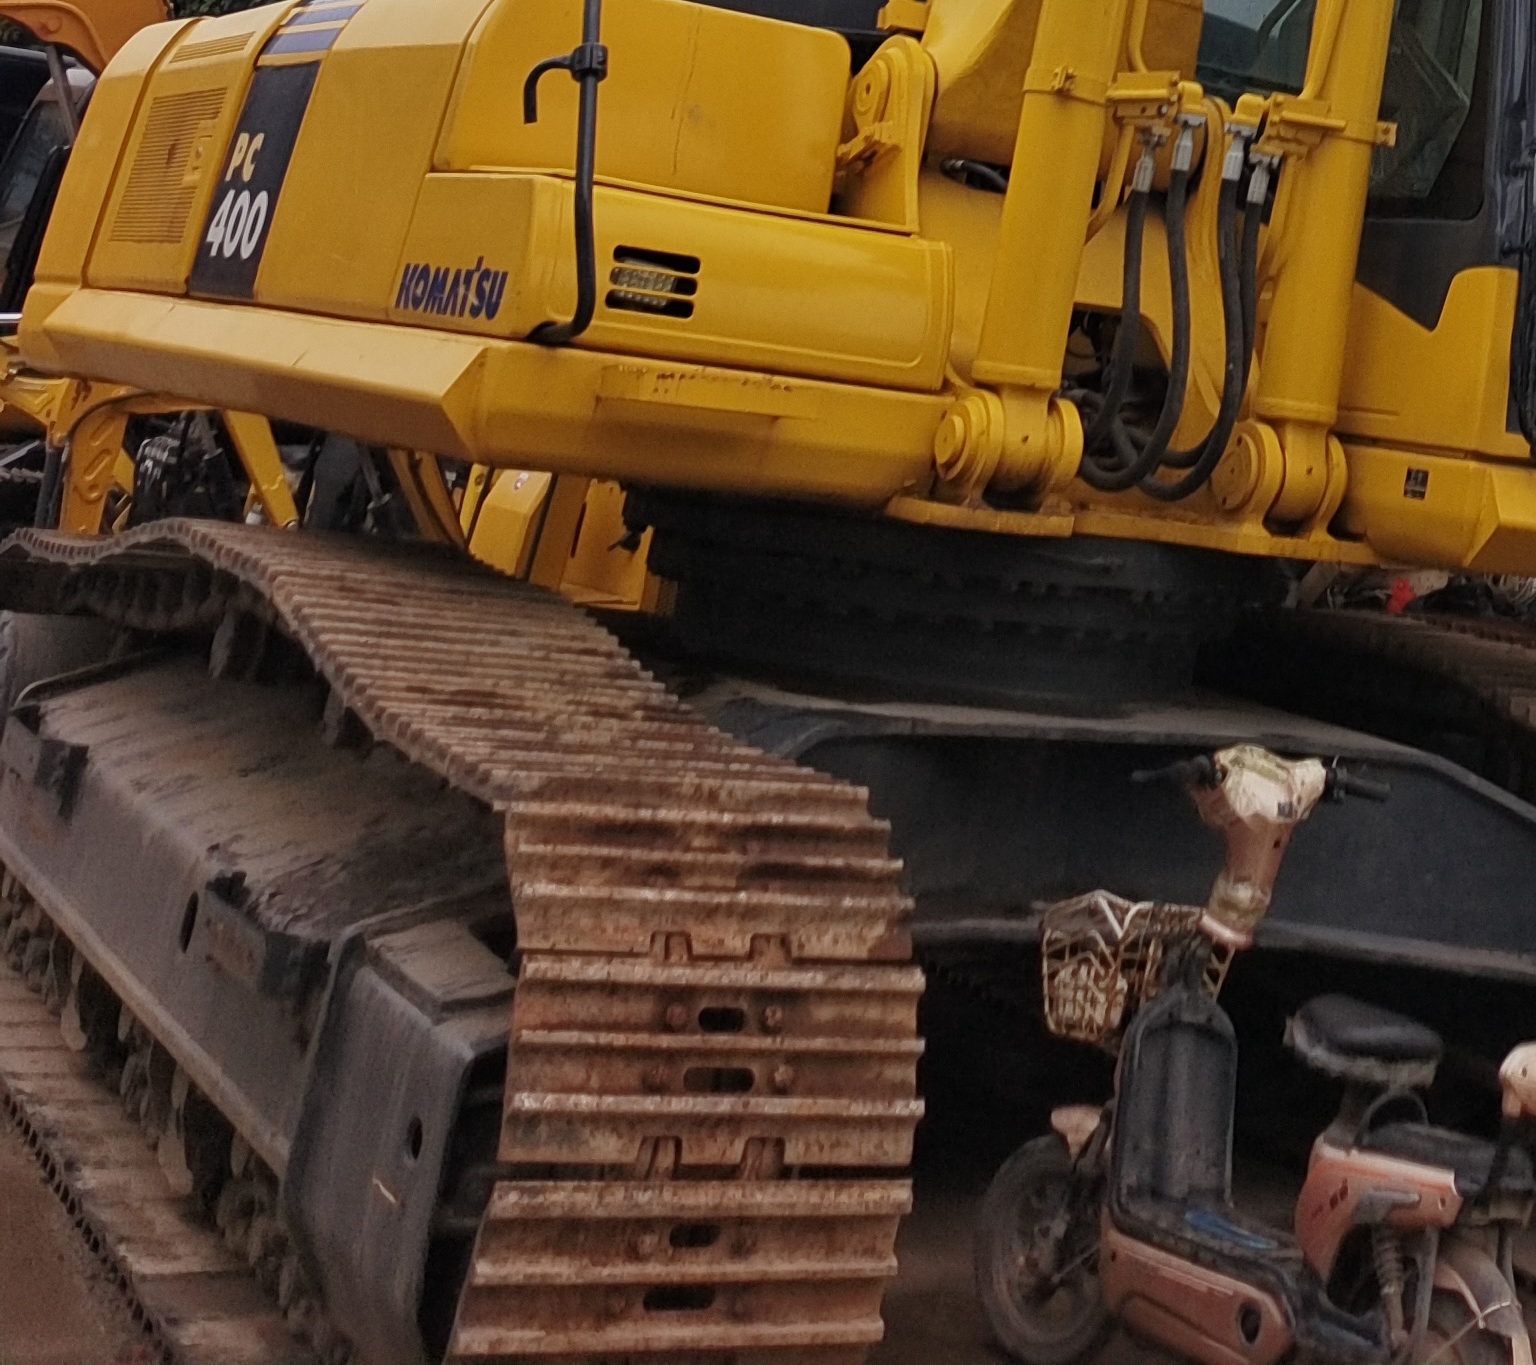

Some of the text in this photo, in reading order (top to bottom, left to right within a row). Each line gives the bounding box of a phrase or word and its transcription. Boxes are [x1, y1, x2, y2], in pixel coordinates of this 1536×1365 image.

[224, 132, 266, 183] PC
[205, 188, 269, 261] 400
[394, 255, 510, 321] KOMATSU
